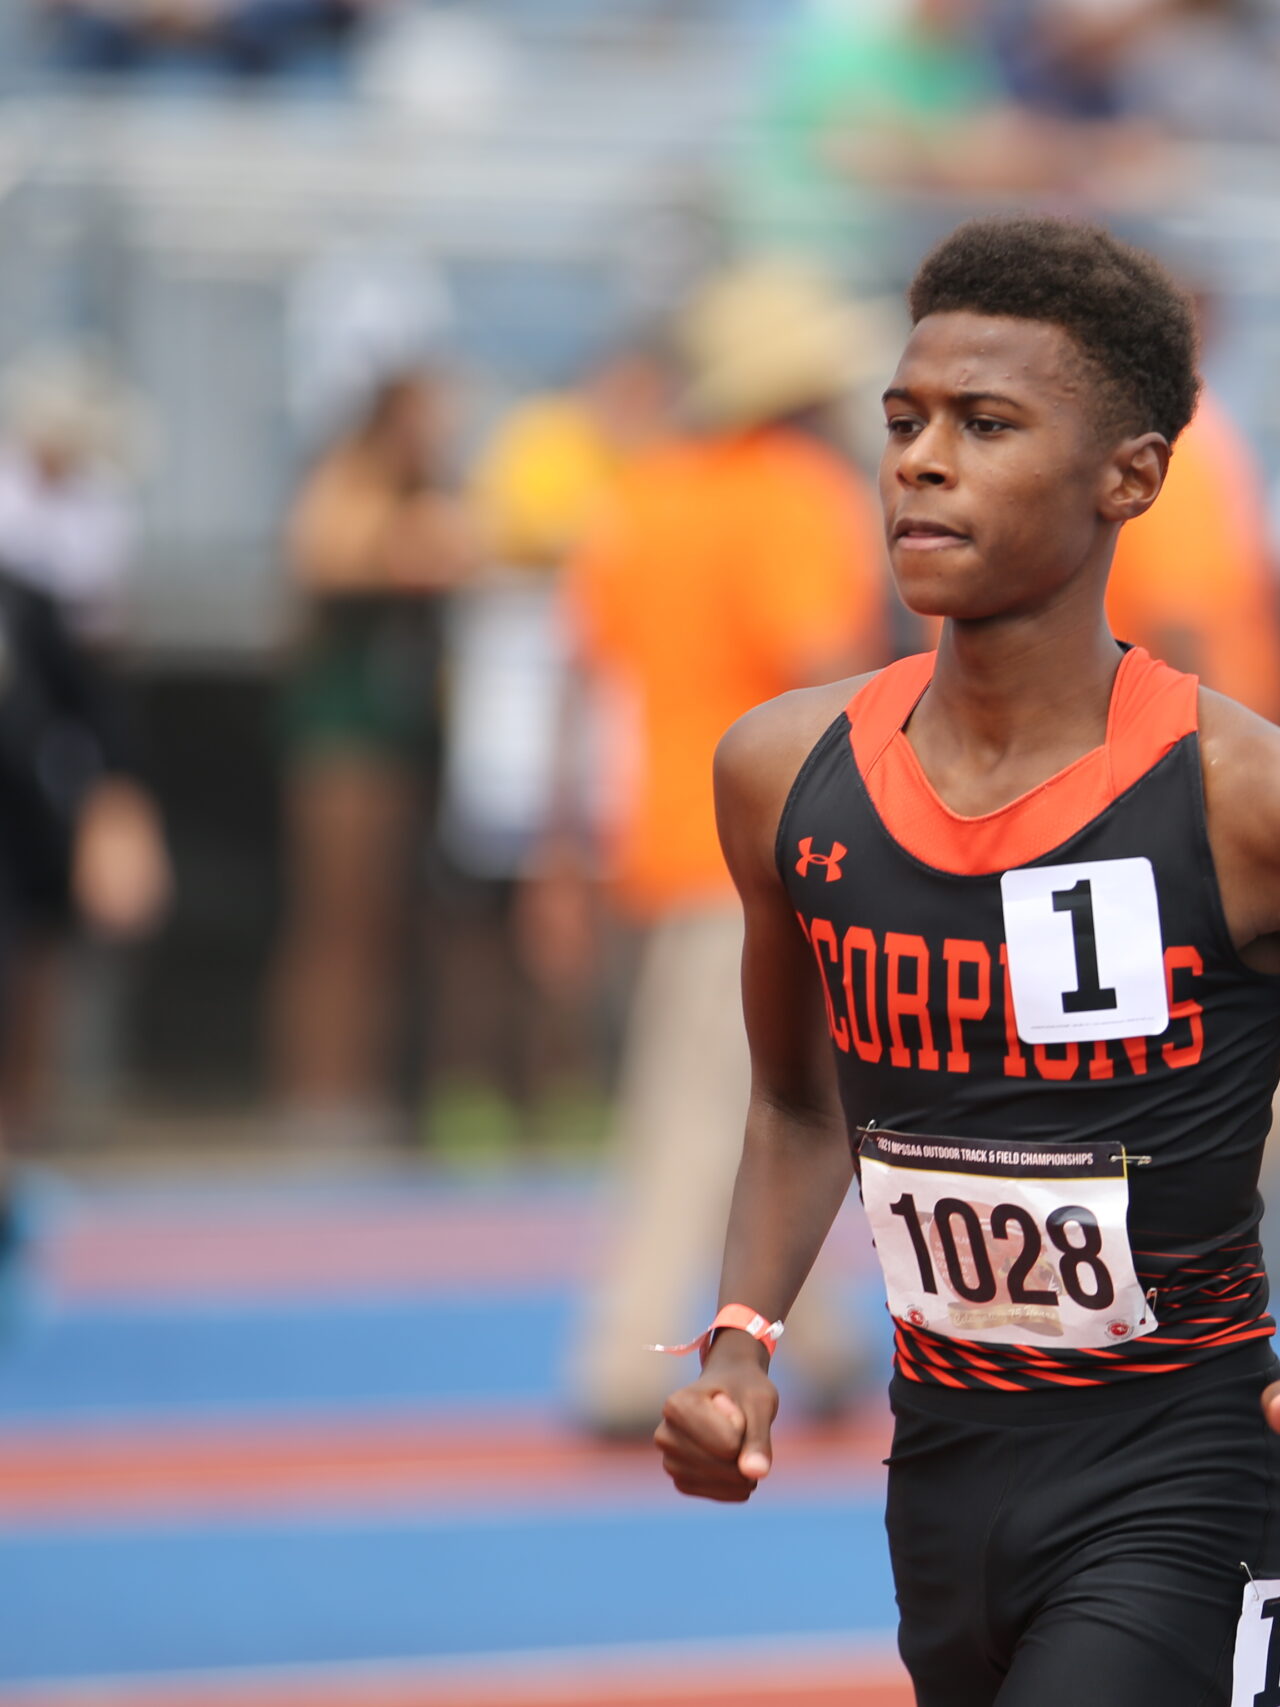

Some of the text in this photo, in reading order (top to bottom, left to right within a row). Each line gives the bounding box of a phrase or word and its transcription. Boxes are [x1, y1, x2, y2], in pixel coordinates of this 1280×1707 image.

[1051, 879, 1117, 1014] 1
[892, 1142, 922, 1157] MPSSAA
[923, 1145, 960, 1160] OUTDOOR
[961, 1148, 987, 1162] TRACK
[989, 1150, 995, 1163] &
[996, 1150, 1019, 1165] FIELD
[1020, 1152, 1093, 1166] CHAMPIONSHIPS
[890, 1193, 1114, 1310] 1028
